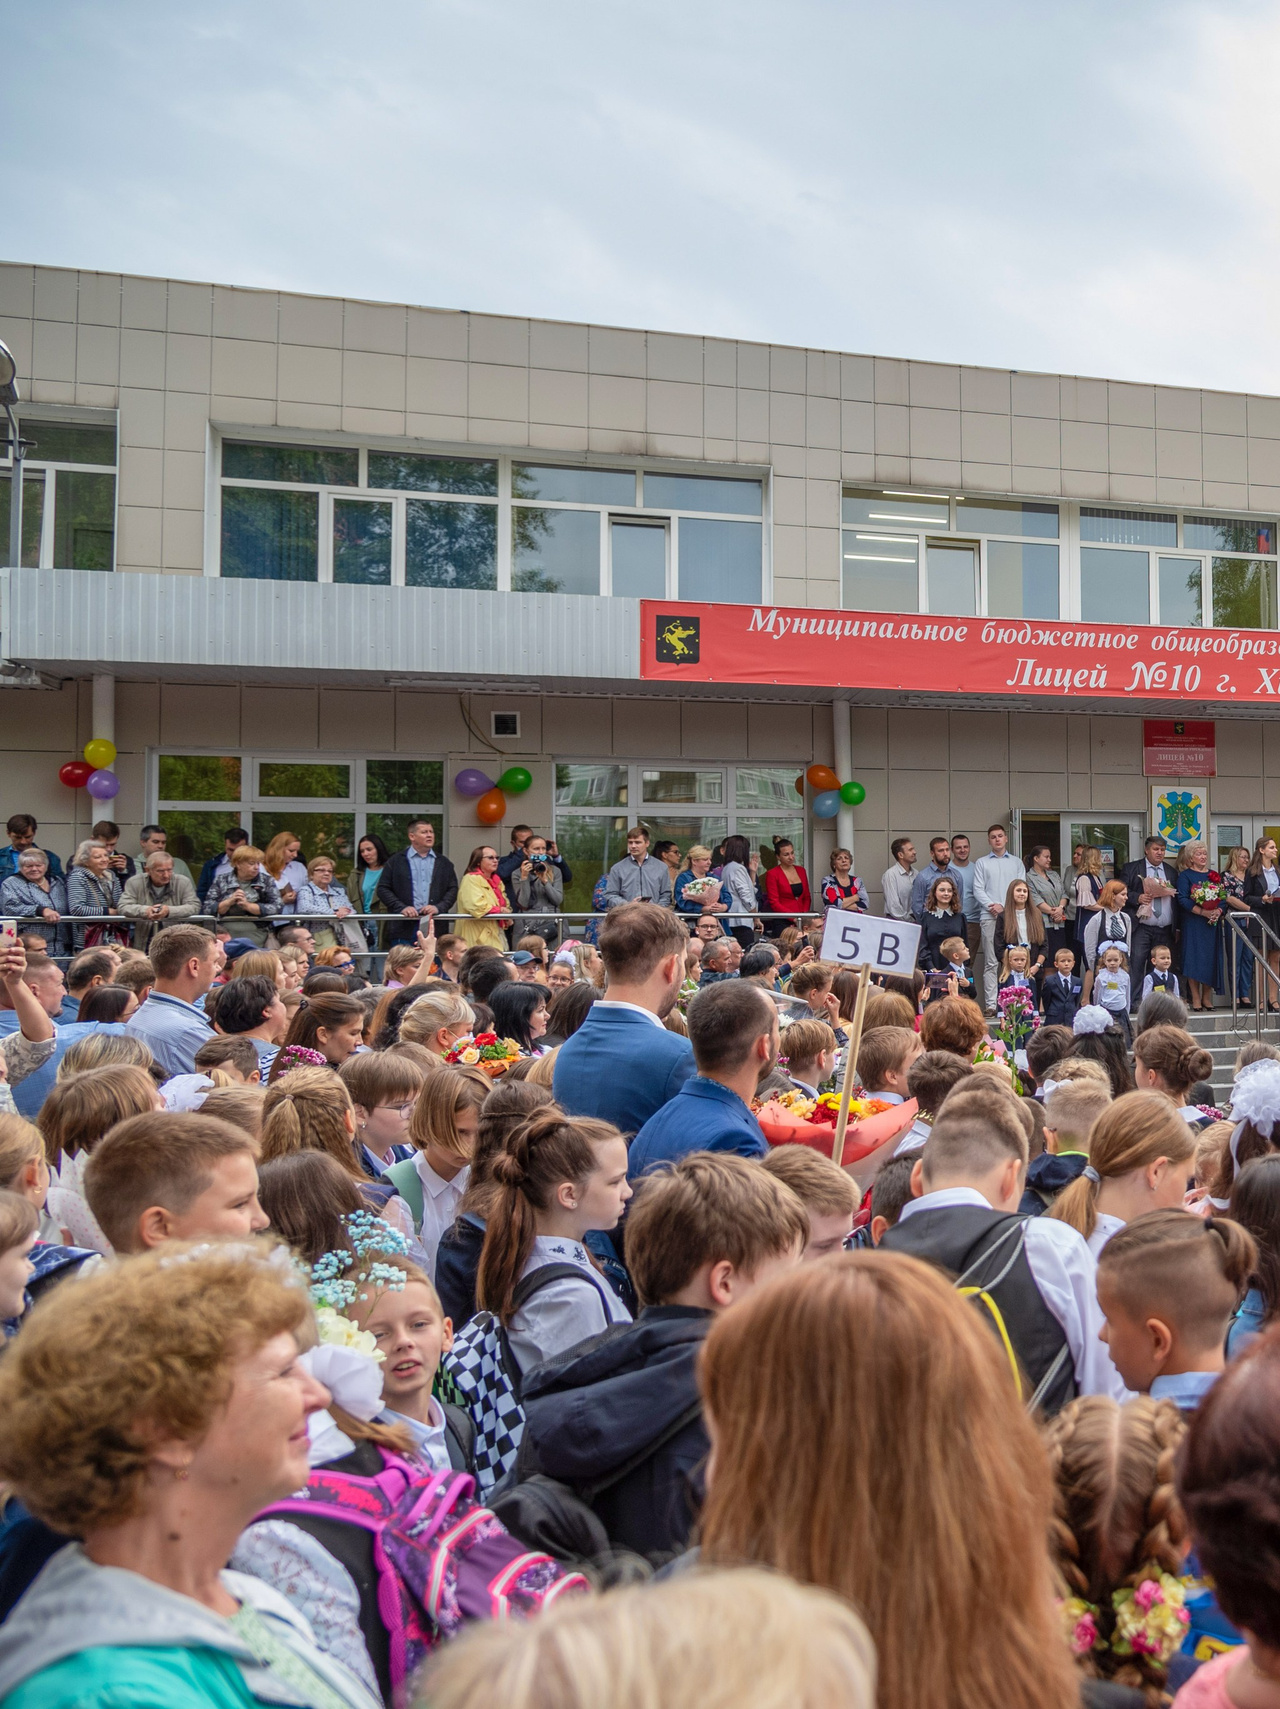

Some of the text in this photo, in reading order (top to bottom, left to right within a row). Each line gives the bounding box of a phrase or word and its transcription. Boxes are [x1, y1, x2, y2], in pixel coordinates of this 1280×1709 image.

[746, 608, 968, 642] Муниципальное
[980, 620, 1139, 650] бюджетное
[1006, 658, 1108, 694] Лицей
[1123, 661, 1201, 693] №10
[1215, 673, 1238, 695] г.
[1156, 752, 1204, 762] ЛИЦЕЙ №10
[836, 925, 861, 960] 5
